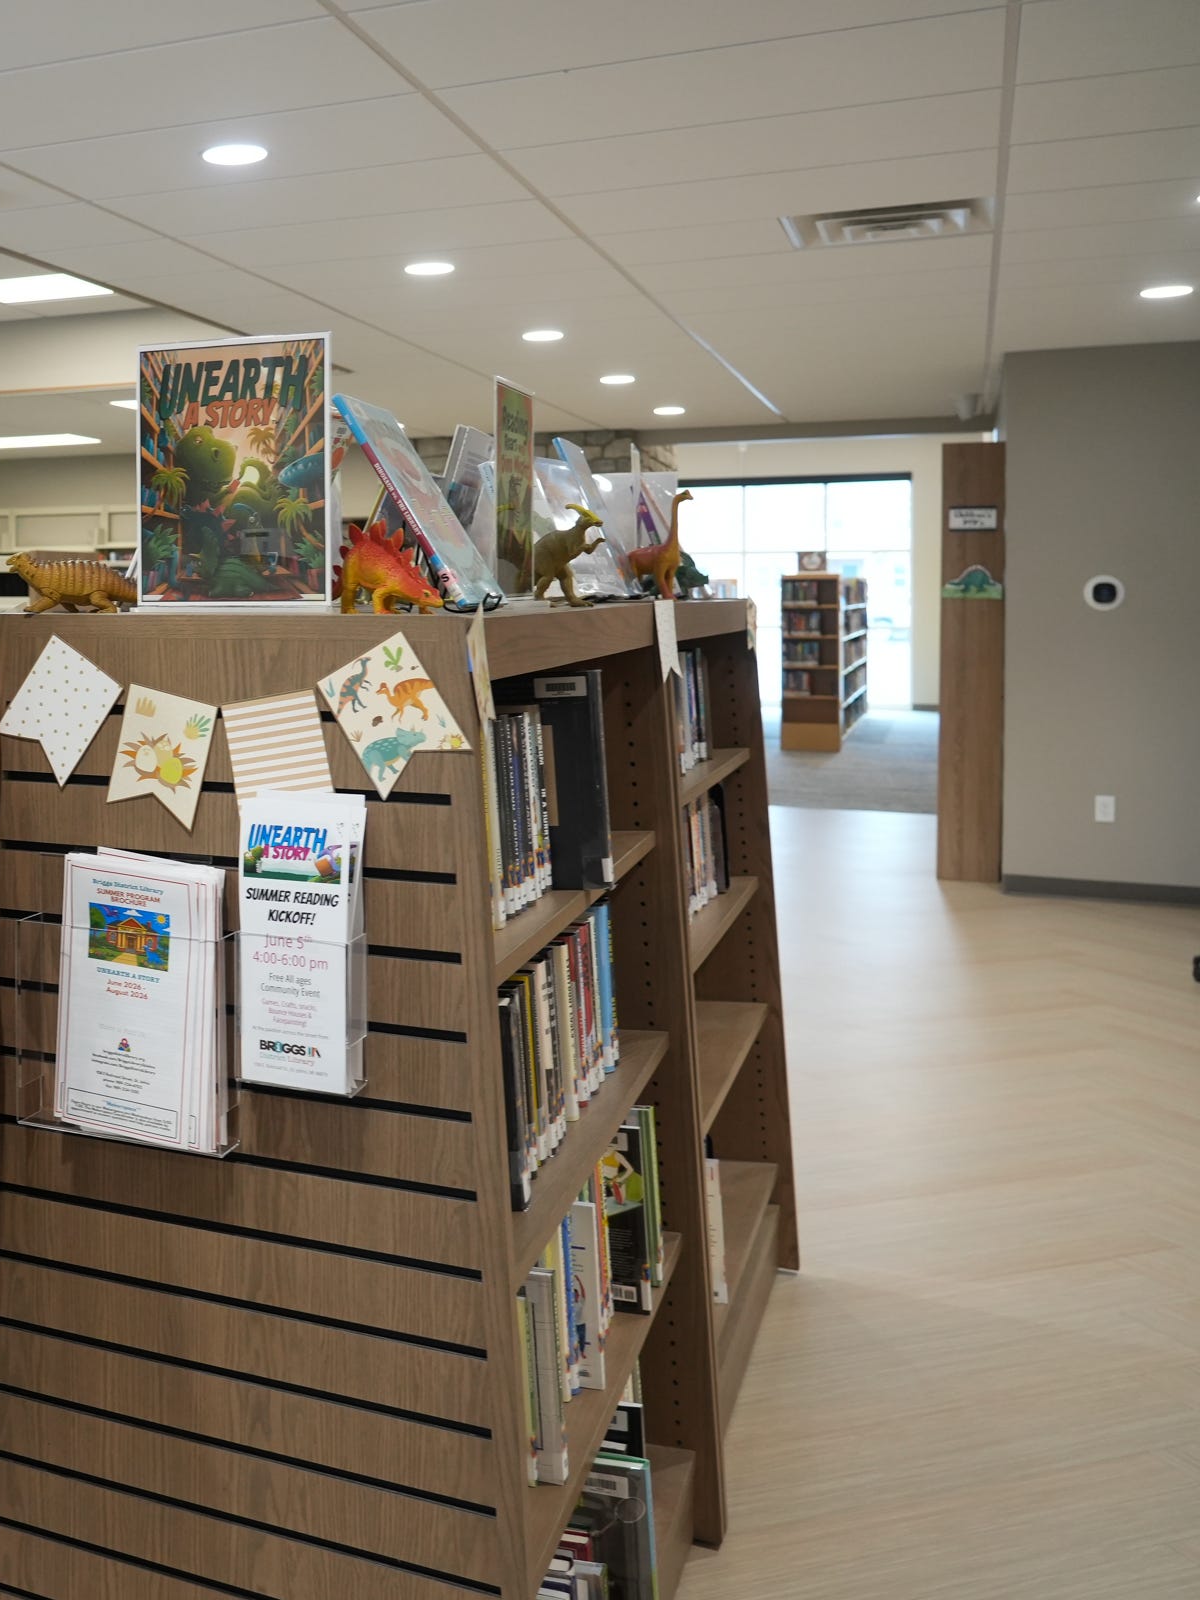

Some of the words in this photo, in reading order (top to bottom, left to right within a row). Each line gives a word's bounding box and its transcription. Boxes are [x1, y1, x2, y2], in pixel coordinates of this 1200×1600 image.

[159, 354, 308, 420] UNEARTH
[183, 402, 200, 430] A
[204, 398, 276, 428] STORY
[373, 462, 394, 493] DINOSAUR
[397, 500, 406, 512] THE
[404, 511, 422, 536] LIBRARY
[248, 824, 327, 853] UNEARTH
[262, 844, 269, 858] A
[272, 846, 311, 861] STORY
[96, 887, 125, 898] SUMMER
[126, 892, 160, 903] PROGRAM
[111, 896, 147, 907] BROCHURE
[246, 888, 291, 902] SUMMER
[293, 892, 339, 907] READING
[267, 909, 316, 925] KICKOFF!
[264, 934, 293, 948] June
[253, 951, 306, 967] 4:00-6:00
[309, 959, 328, 972] pm
[96, 966, 130, 978] UNEARTH
[136, 974, 160, 984] STORY
[269, 972, 284, 983] Free
[285, 974, 294, 983] All
[296, 978, 312, 987] ages
[107, 978, 122, 987] June
[123, 981, 141, 991] 2026
[261, 983, 300, 997] Community
[301, 988, 320, 998] Event
[106, 986, 129, 996] August
[130, 990, 148, 1000] 2026
